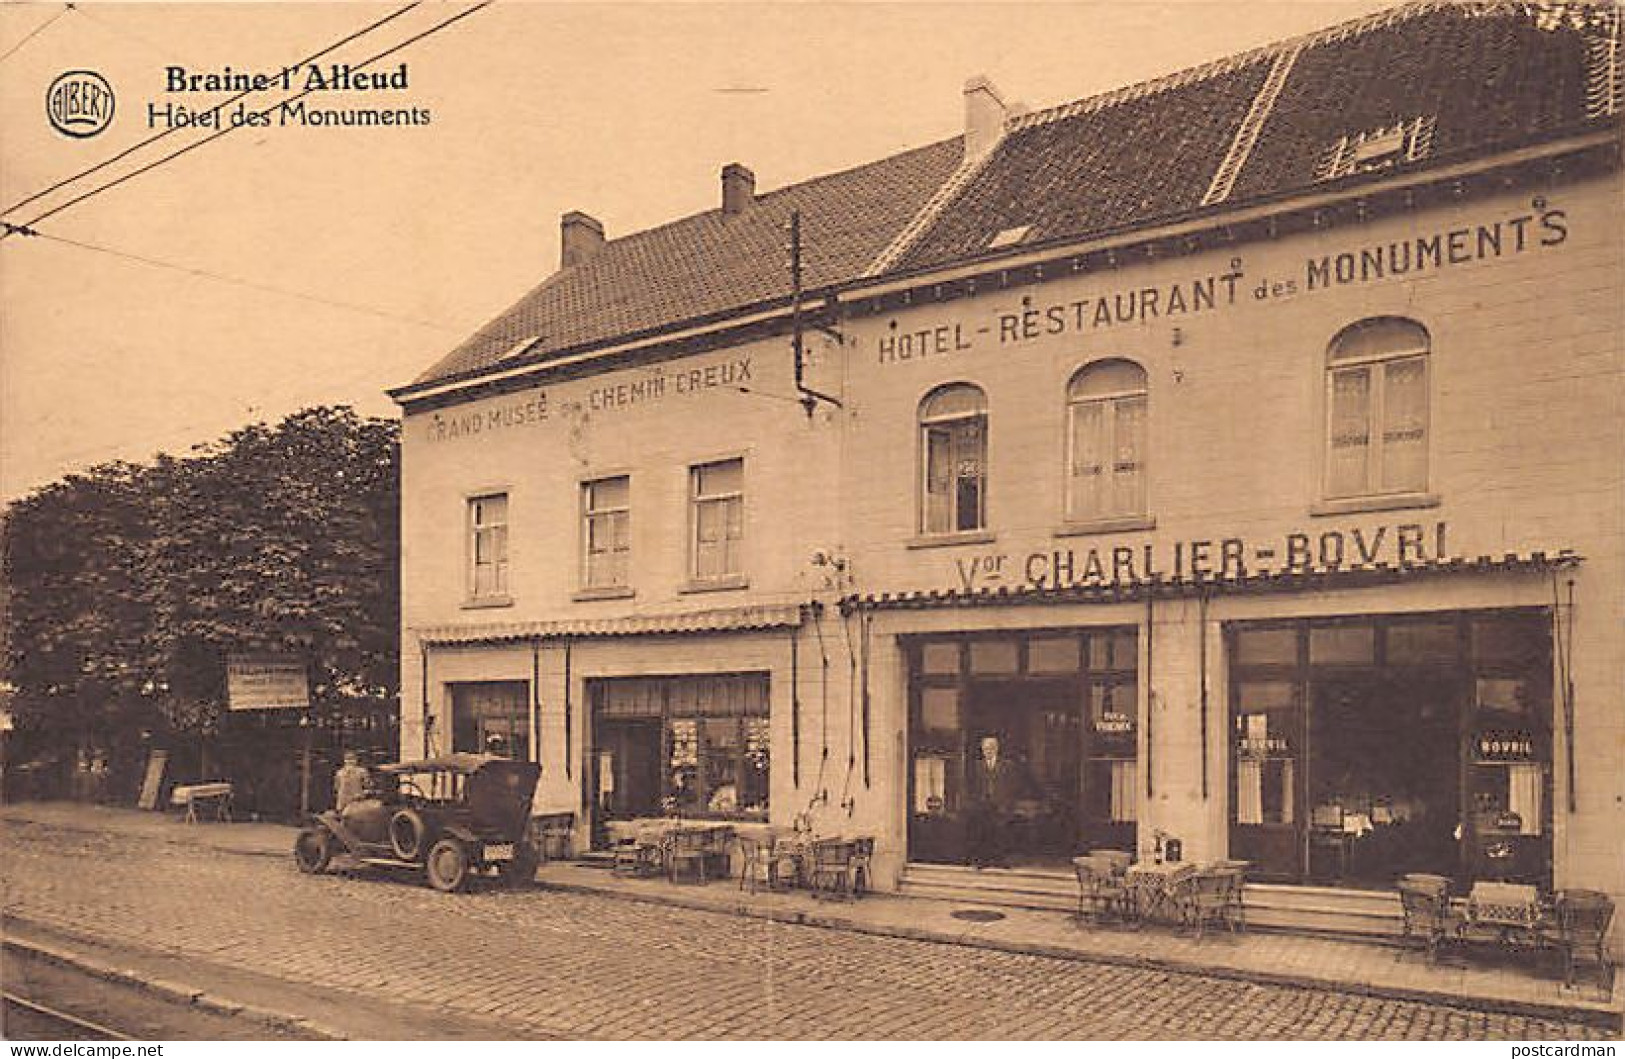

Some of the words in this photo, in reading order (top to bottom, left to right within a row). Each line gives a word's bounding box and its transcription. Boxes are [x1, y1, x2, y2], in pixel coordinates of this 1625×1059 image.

[1253, 279, 1297, 300] des
[1307, 210, 1566, 291] MONUMENTS
[590, 376, 666, 410] CHEMIN
[676, 357, 751, 393] CREUX
